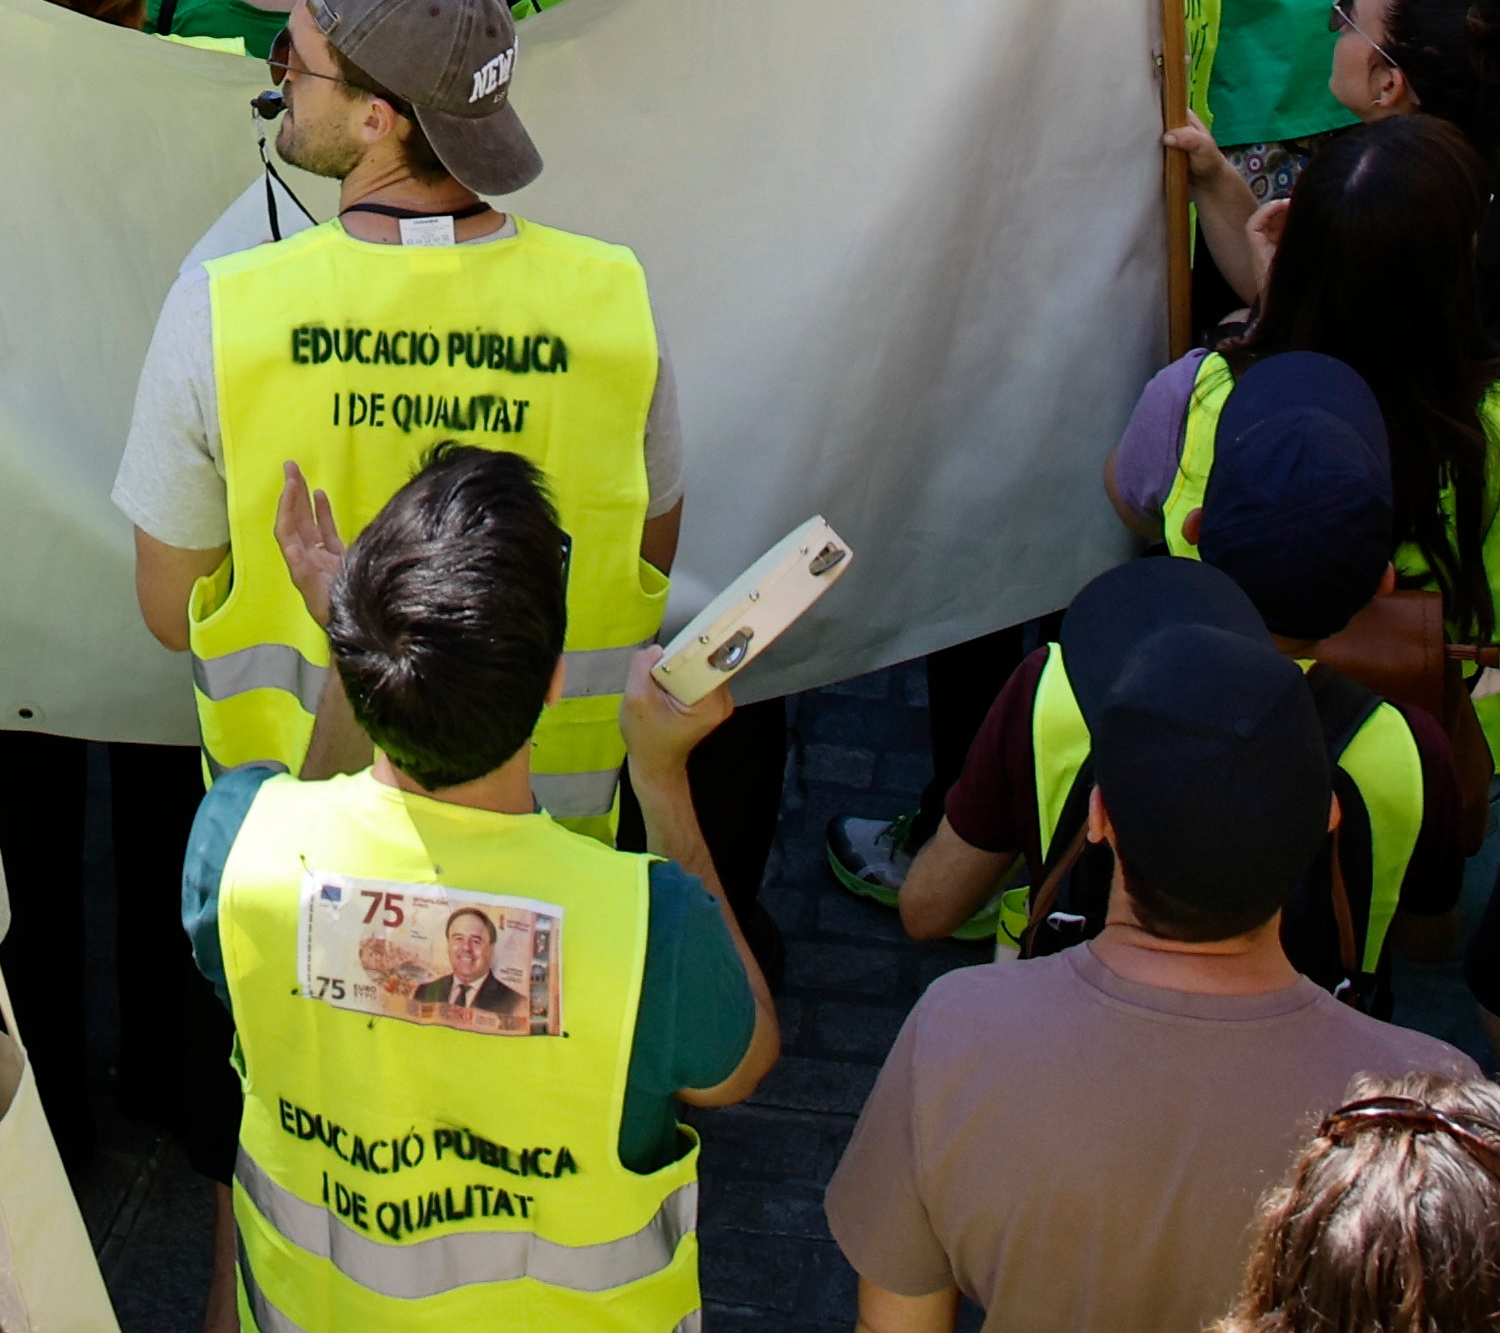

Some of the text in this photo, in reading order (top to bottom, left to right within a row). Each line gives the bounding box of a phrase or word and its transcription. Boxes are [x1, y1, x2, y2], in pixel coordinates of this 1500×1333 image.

[468, 47, 513, 103] NEW
[289, 321, 570, 376] EDUCACIÓ PÚBLICA
[333, 391, 532, 434] I DE QUALITAT
[360, 890, 404, 928] 75
[316, 976, 346, 1000] 75
[277, 1095, 578, 1181] EDUCACIÓ PÚBLICA
[319, 1168, 536, 1243] I DE QUALITAT
